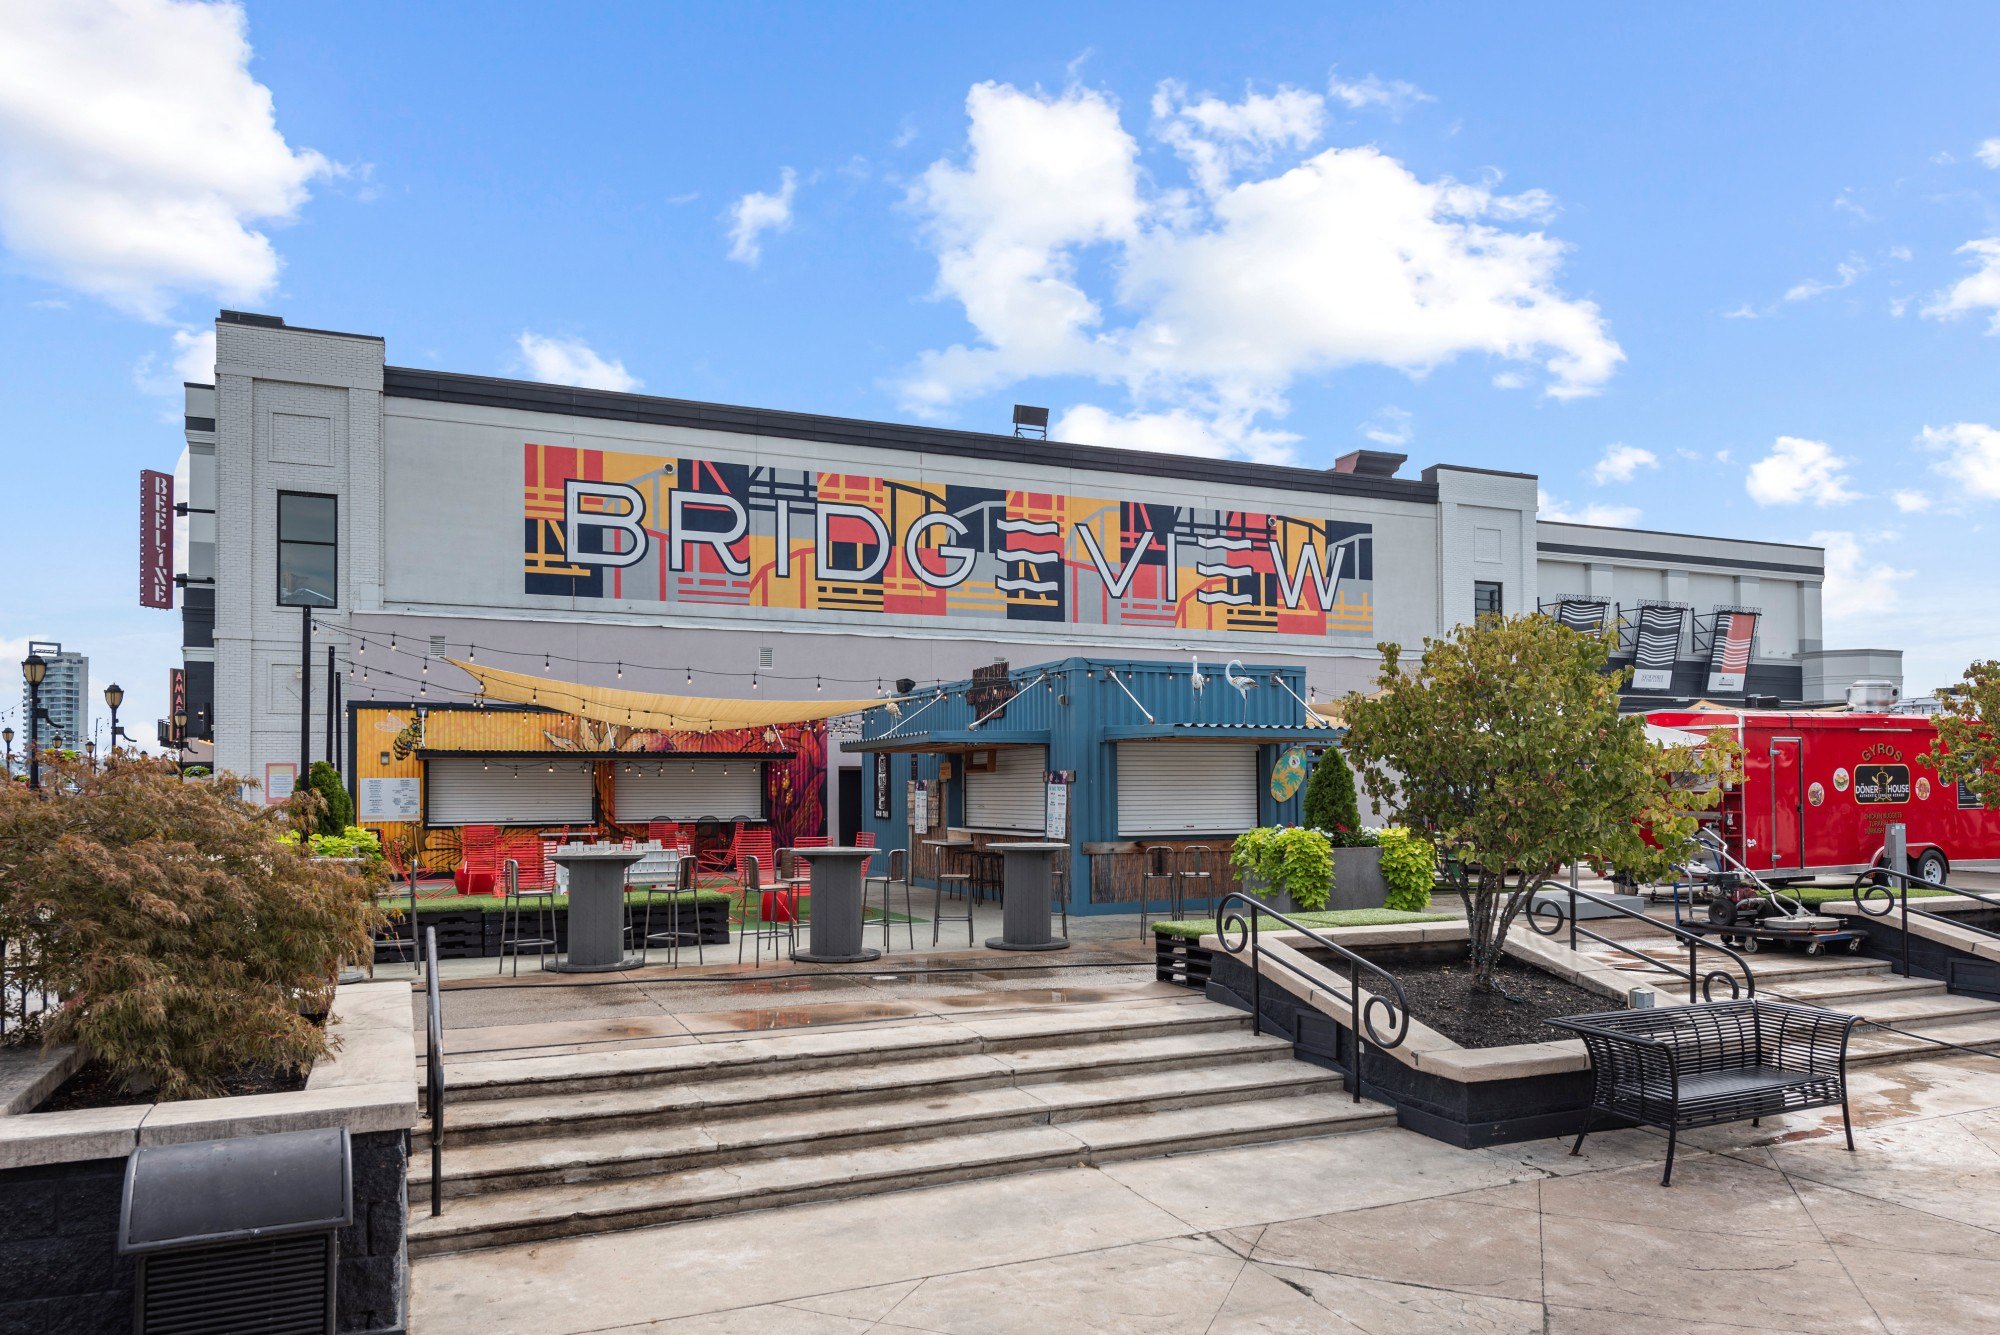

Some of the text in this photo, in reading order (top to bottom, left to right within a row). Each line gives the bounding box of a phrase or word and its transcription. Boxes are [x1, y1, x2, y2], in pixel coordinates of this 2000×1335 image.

[155, 476, 168, 603] BEELINE
[564, 478, 1346, 612] BRIDGEVIEW
[1856, 783, 1910, 795] DÖNER HOUSE
[1861, 743, 1902, 762] GYROS
